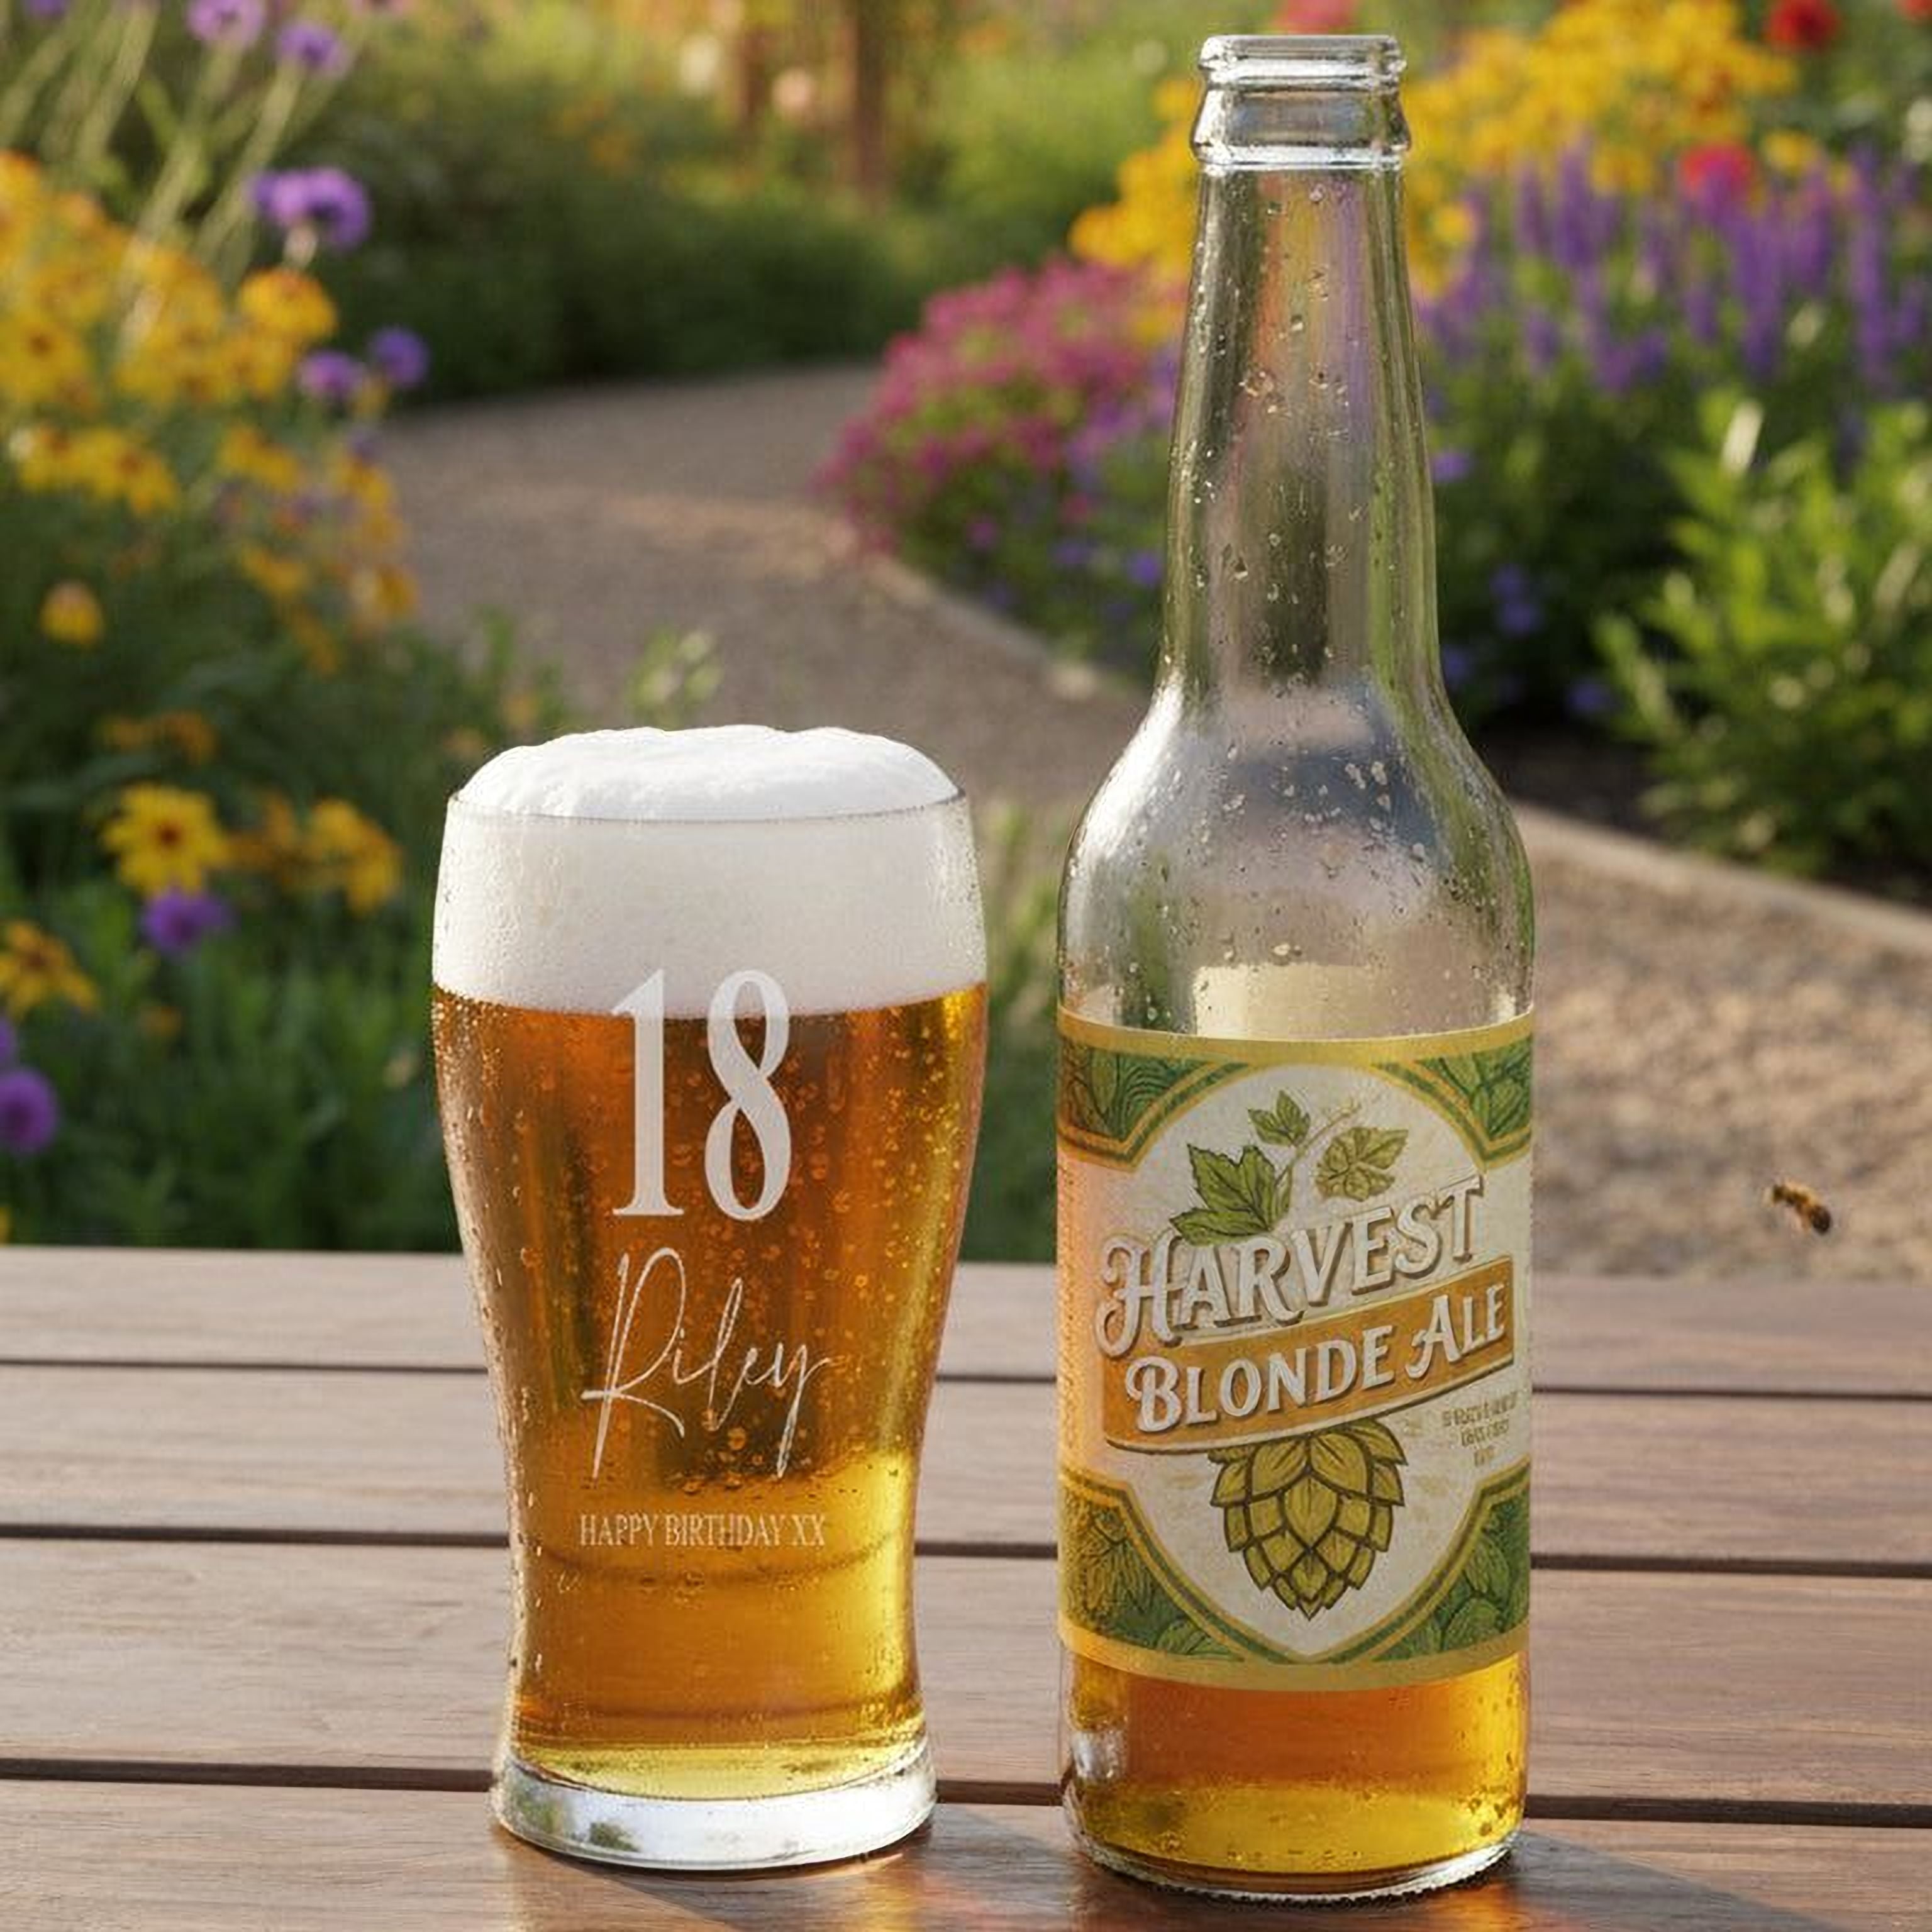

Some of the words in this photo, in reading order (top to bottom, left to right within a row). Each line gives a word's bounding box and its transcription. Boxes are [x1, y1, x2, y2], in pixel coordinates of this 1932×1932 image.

[612, 969, 792, 1221] 18
[1096, 1172, 1485, 1358] HARVEST
[1126, 1324, 1396, 1434] BLONDE
[1405, 1282, 1506, 1380] ALE
[581, 1246, 831, 1479] Riley
[580, 1514, 658, 1546] HAPPY
[664, 1514, 786, 1546] BIRTHDAY
[791, 1514, 826, 1546] XX
